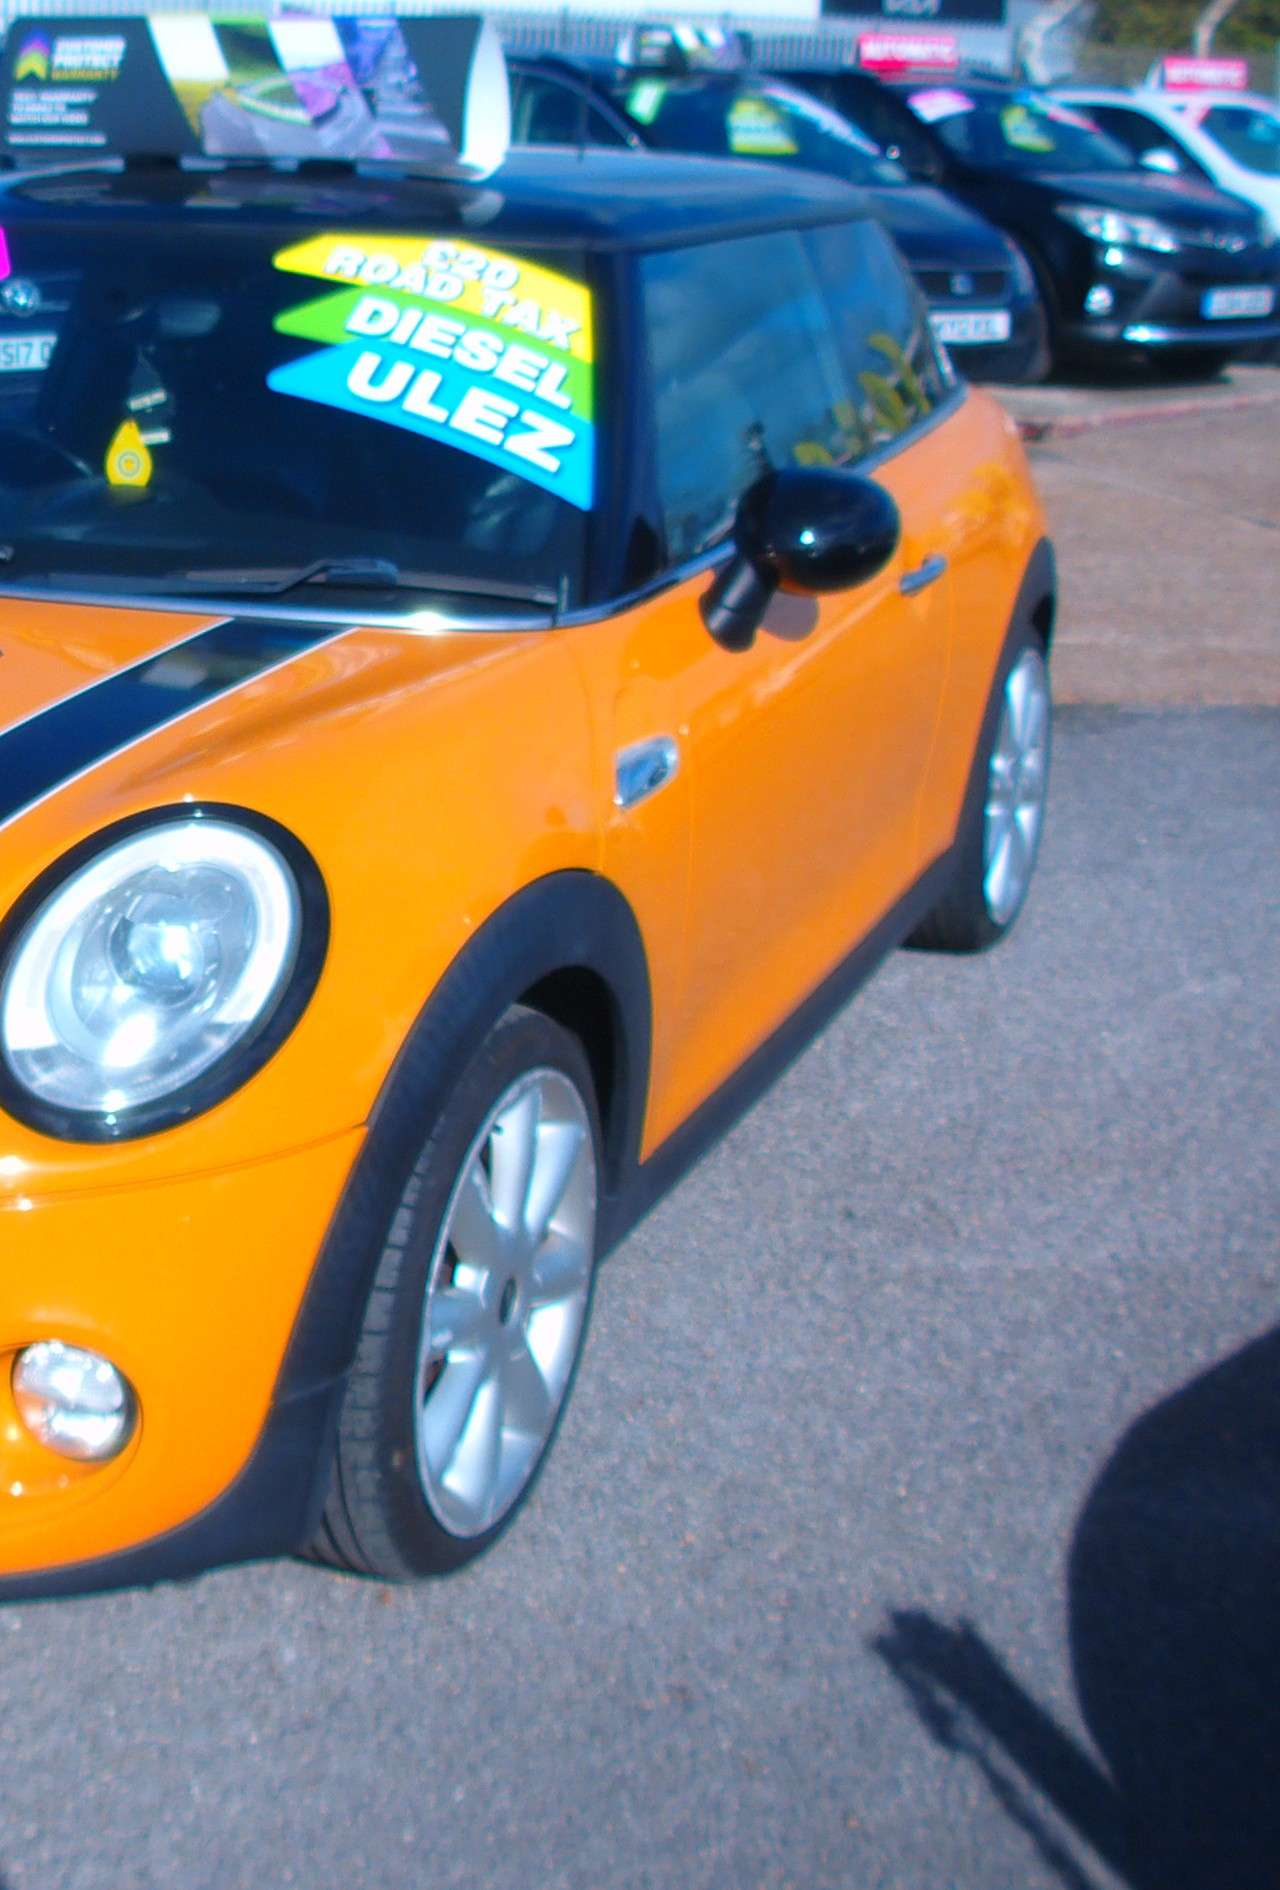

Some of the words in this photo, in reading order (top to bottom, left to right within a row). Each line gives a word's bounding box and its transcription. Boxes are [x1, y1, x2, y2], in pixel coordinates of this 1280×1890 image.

[323, 245, 465, 303] ROAD
[480, 286, 581, 352] TAX
[421, 240, 519, 291] £20
[344, 295, 574, 411] DIESEL
[346, 350, 577, 474] ULEZ
